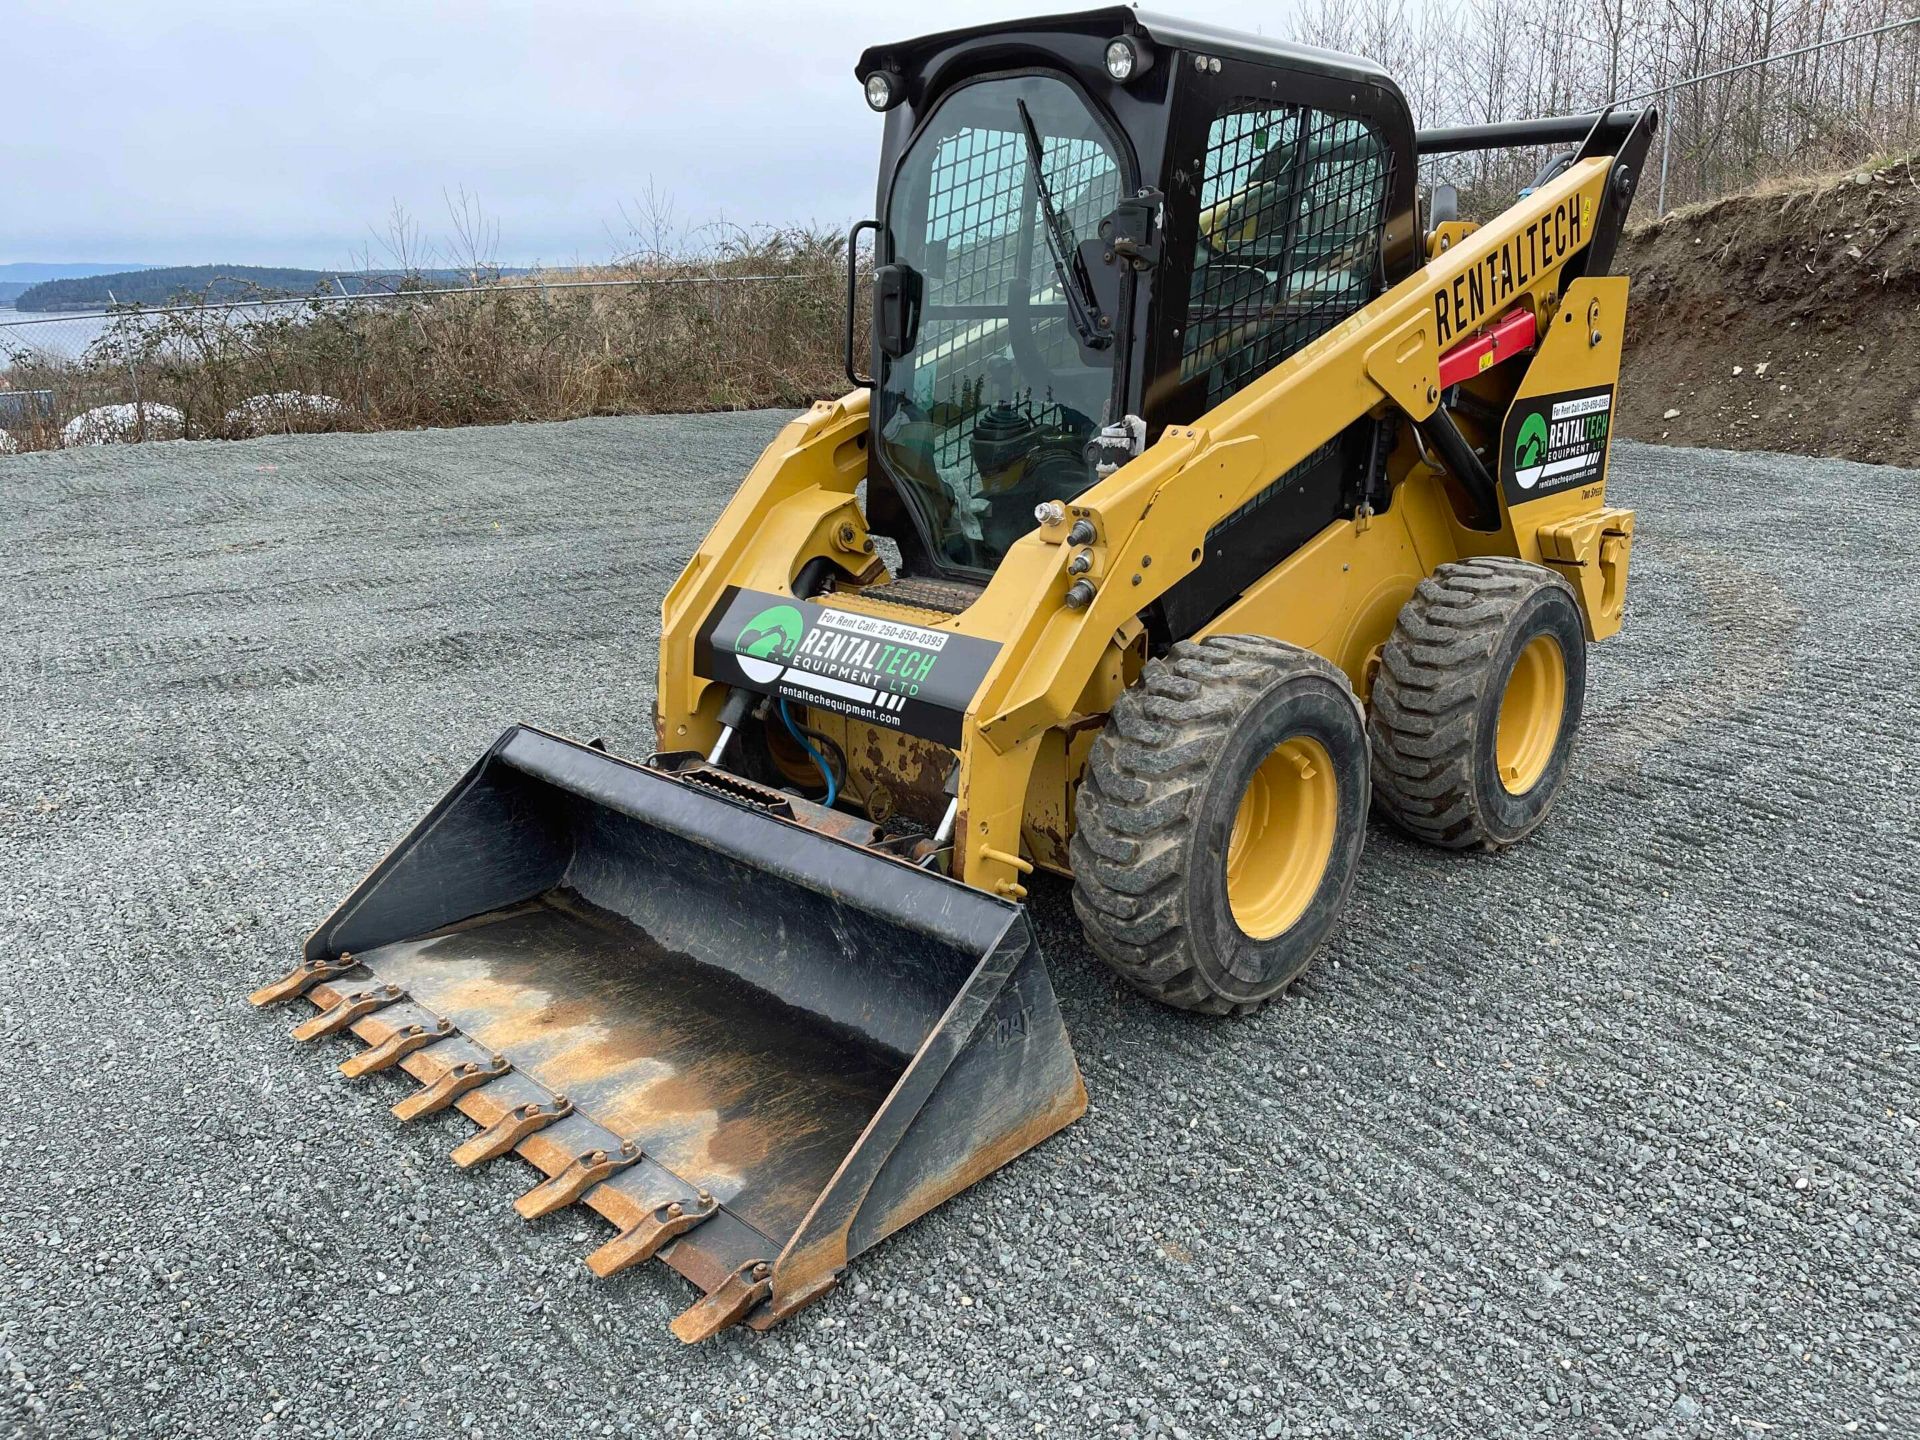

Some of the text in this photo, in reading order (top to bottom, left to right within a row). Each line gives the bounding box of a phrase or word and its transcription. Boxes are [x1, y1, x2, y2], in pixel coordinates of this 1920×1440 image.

[1435, 193, 1581, 347] RENTALTECH
[1548, 440, 1605, 462] EQUIPMENT LTD
[1549, 413, 1608, 449] RENTALTECH
[1538, 468, 1597, 489] rentaltechequipment.com
[821, 612, 944, 646] For Rent Call: 250-850-0395
[793, 655, 919, 696] EQUIPMENT LTD
[800, 628, 938, 682] RENTALTECH
[779, 685, 901, 726] rentaltechequipment.com
[996, 1005, 1033, 1050] CAT
